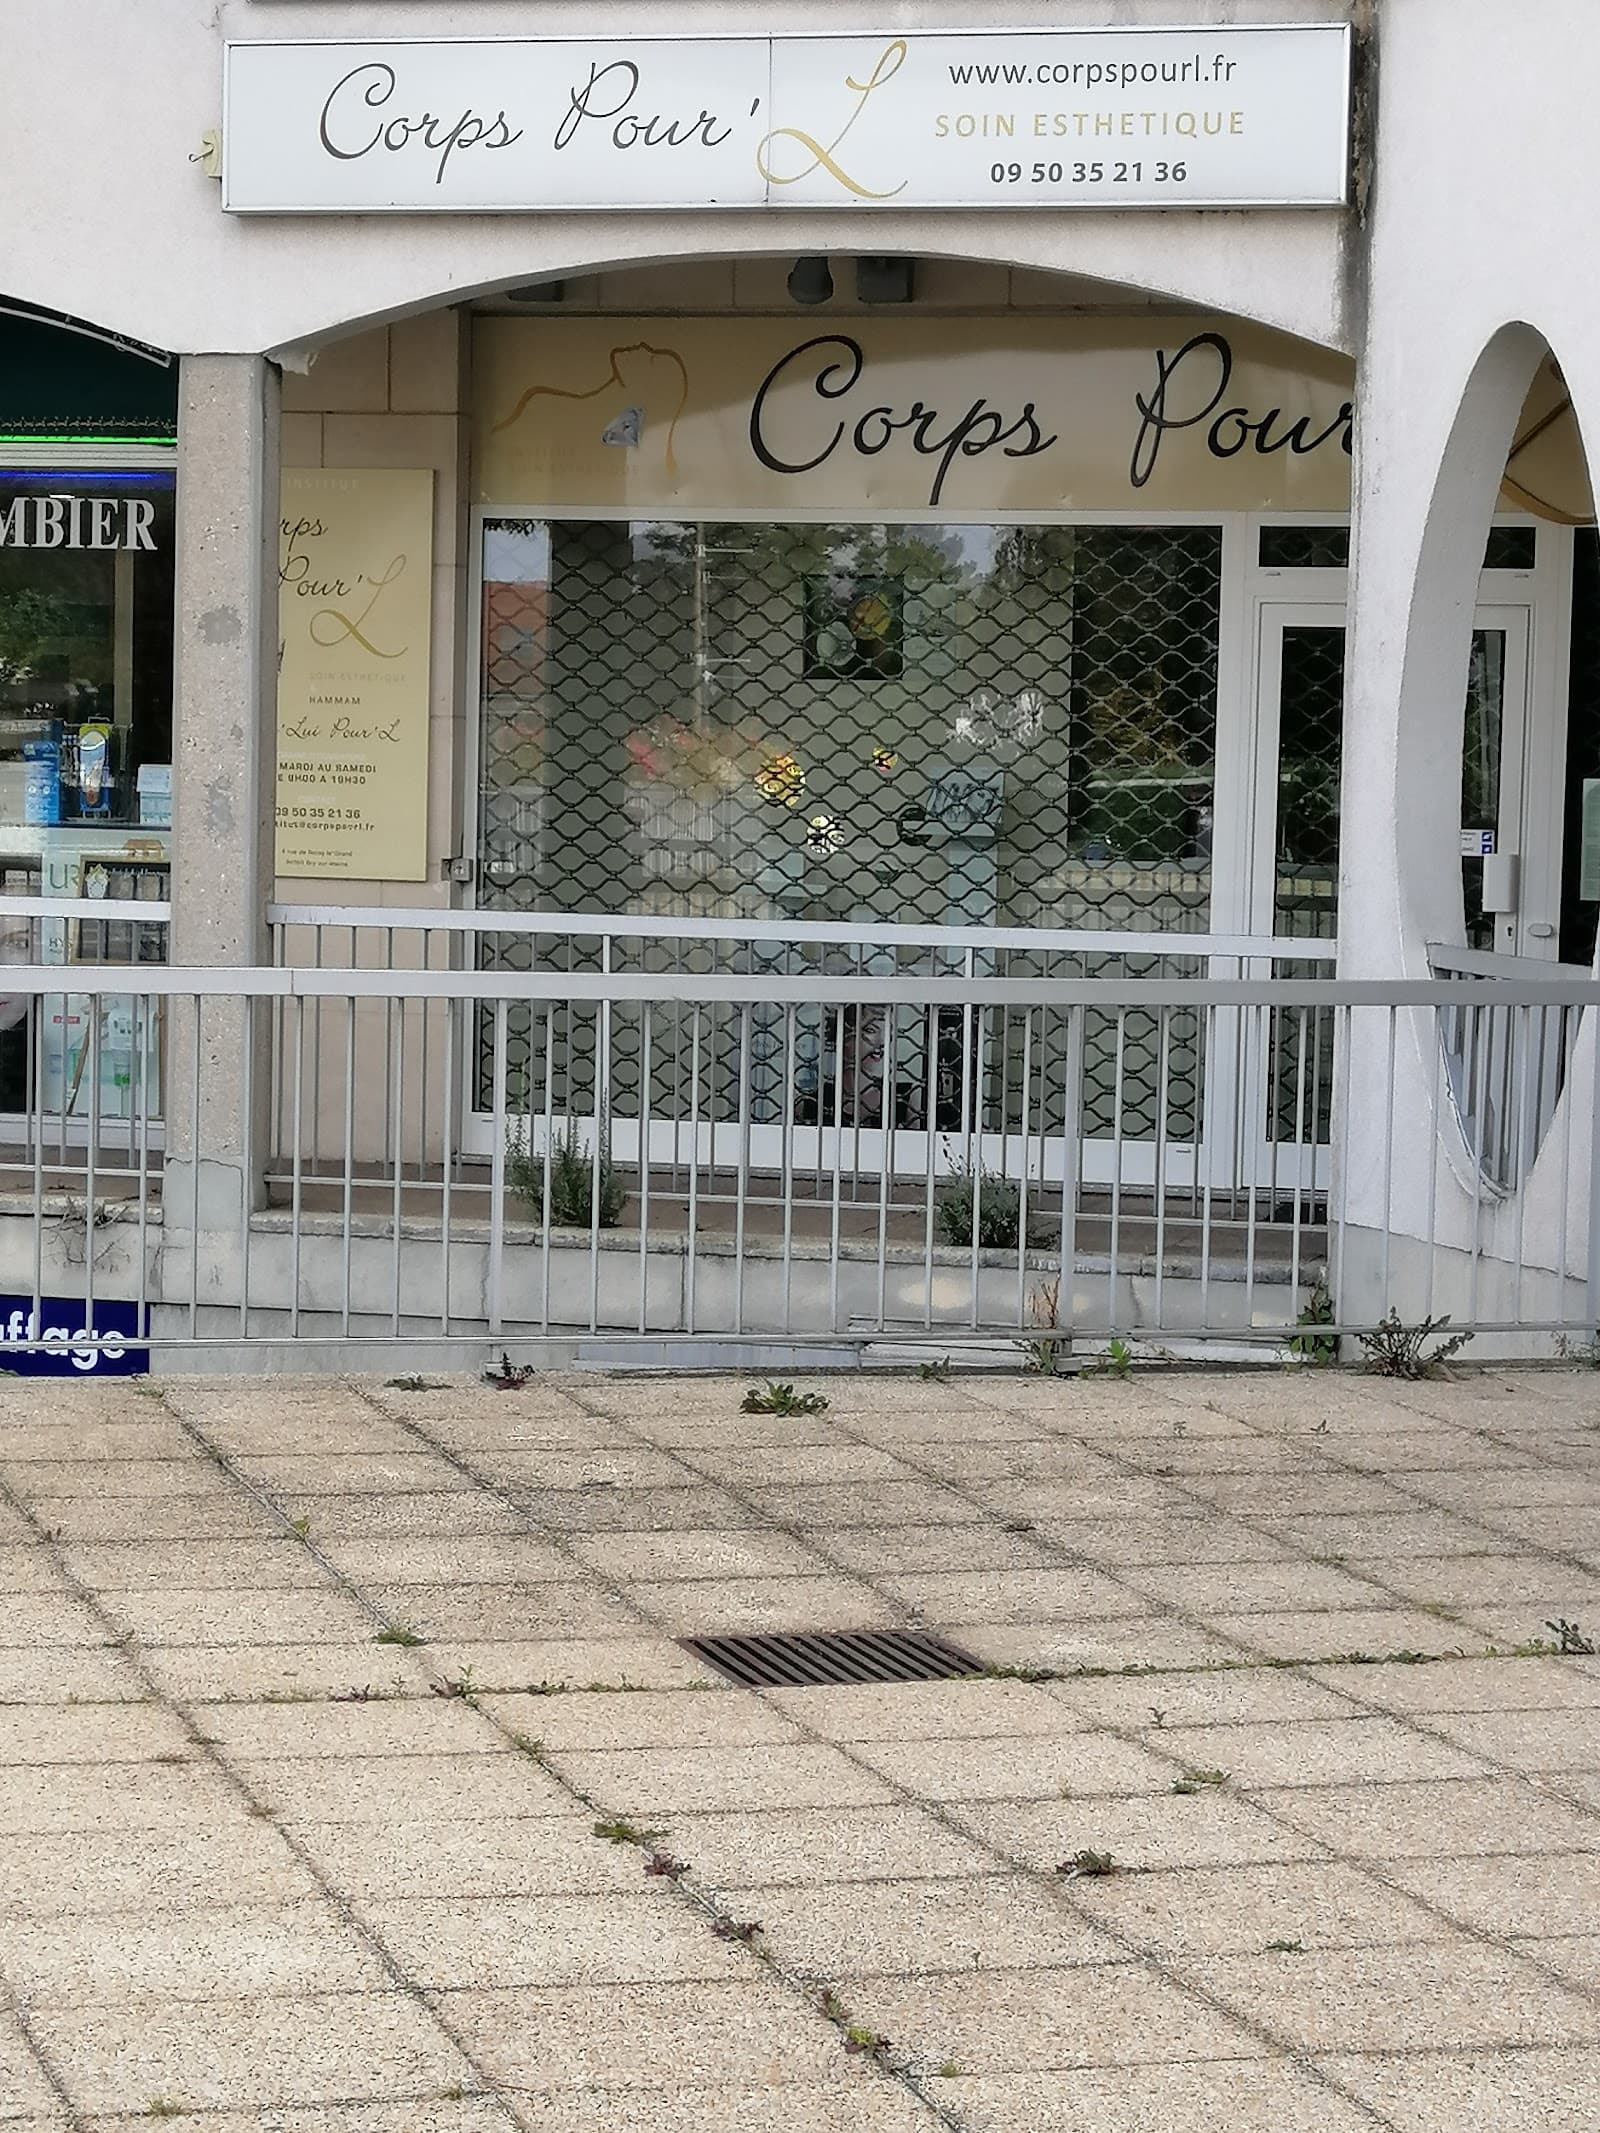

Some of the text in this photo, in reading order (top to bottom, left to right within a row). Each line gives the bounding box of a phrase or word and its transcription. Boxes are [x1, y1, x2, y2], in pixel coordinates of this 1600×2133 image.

[949, 53, 1237, 89] www.corpspourl.fr
[320, 62, 523, 184] Corps
[935, 111, 1246, 139] SOIN ESTHETIQUE
[991, 161, 1187, 183] 09 50 35 21 36
[750, 333, 1057, 506] Corps
[308, 695, 361, 705] HAMMAM
[317, 764, 332, 773] AU
[291, 807, 307, 818] 50
[309, 808, 325, 818] 35
[327, 808, 343, 819] 21
[345, 809, 361, 820] 36
